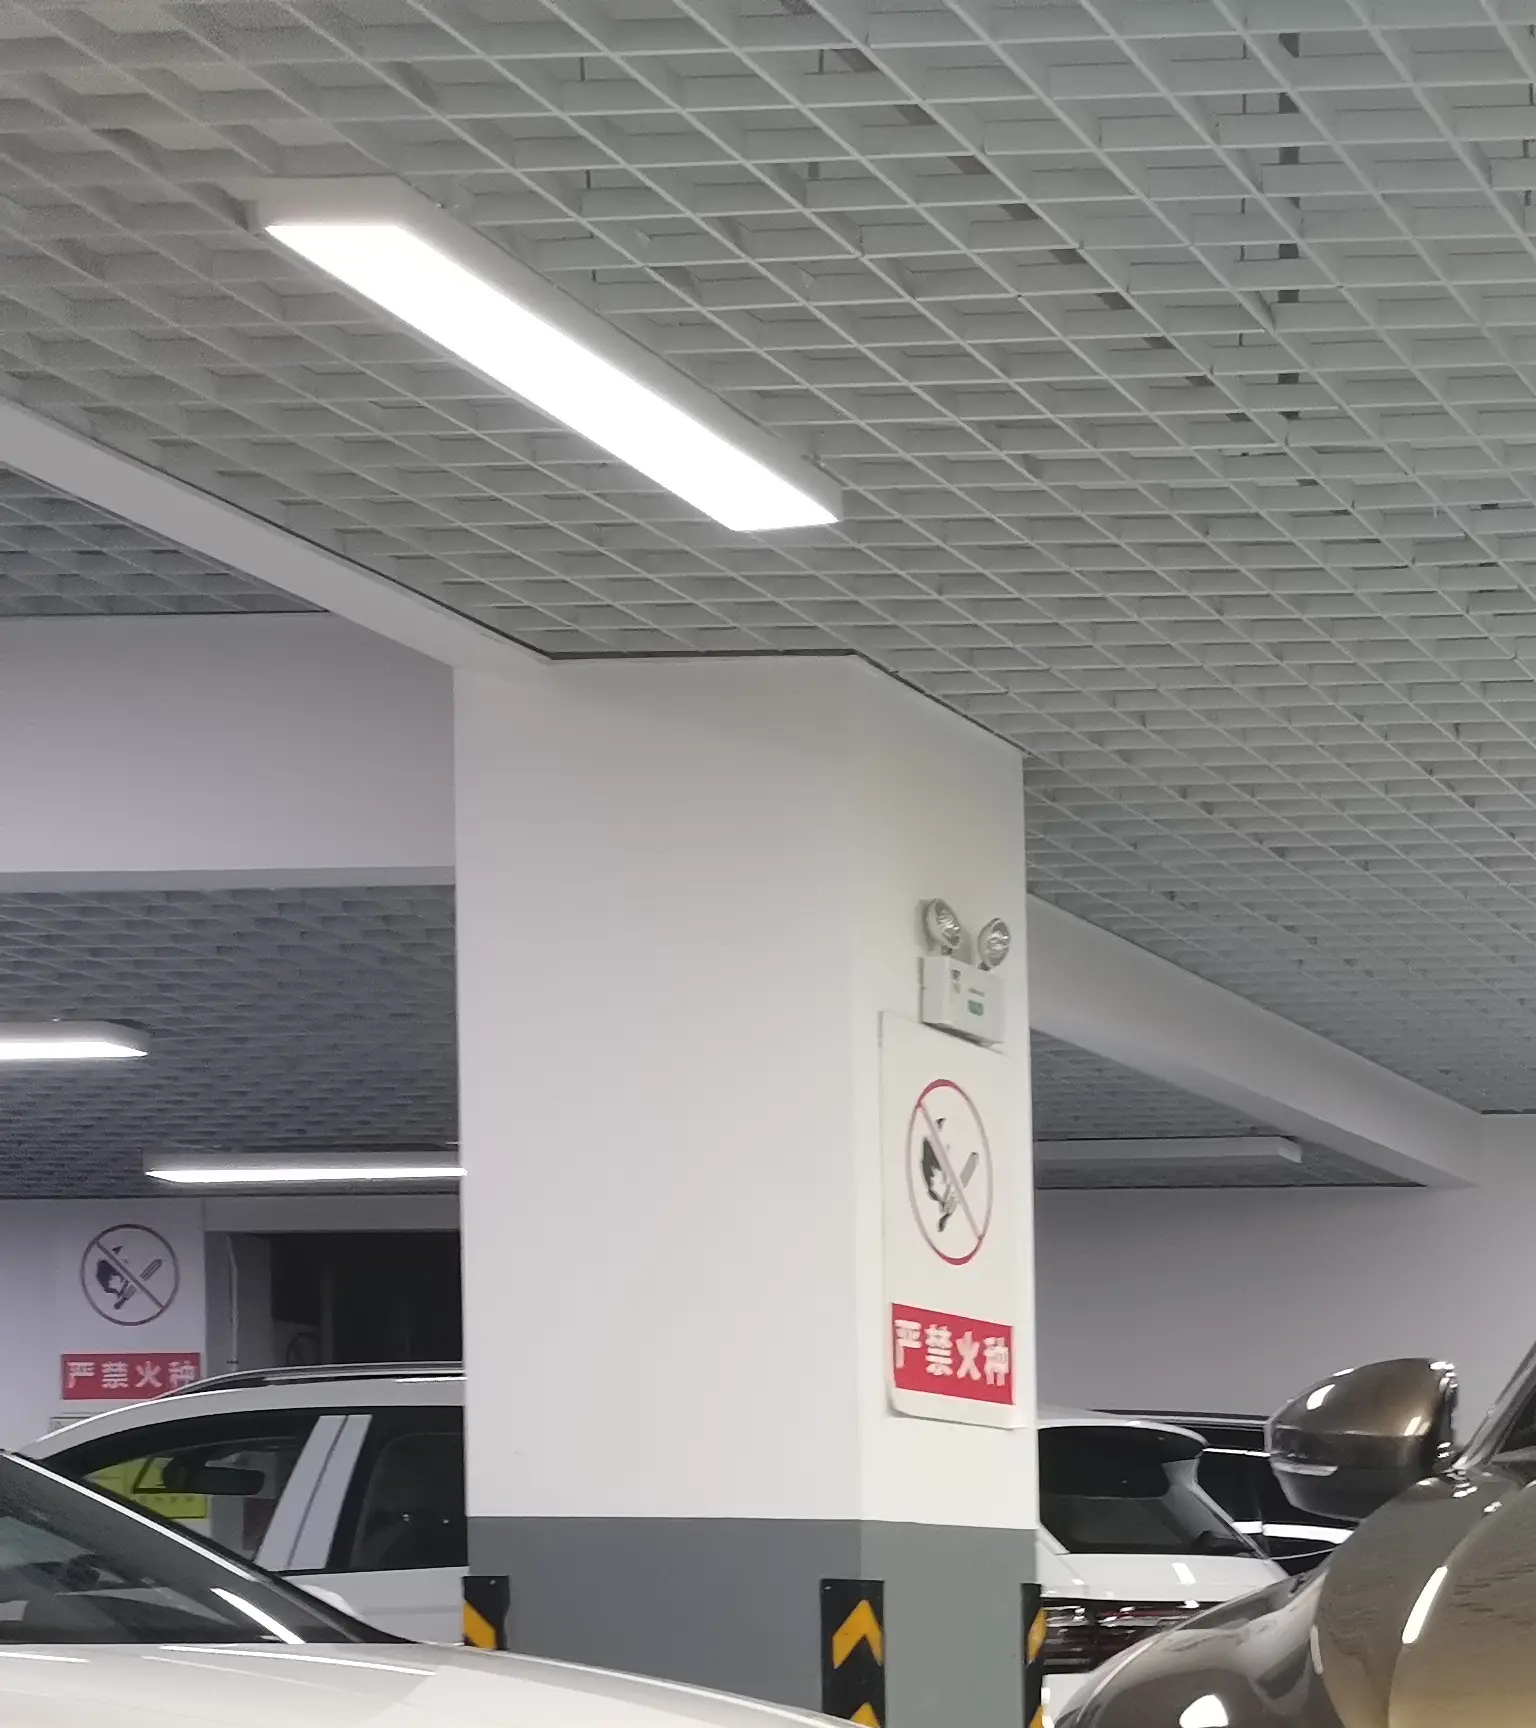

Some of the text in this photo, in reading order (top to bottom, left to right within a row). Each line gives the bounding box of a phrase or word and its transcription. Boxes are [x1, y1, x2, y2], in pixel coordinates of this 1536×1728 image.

[65, 1360, 198, 1390] 严禁火种
[895, 1318, 1010, 1387] 严禁火种
